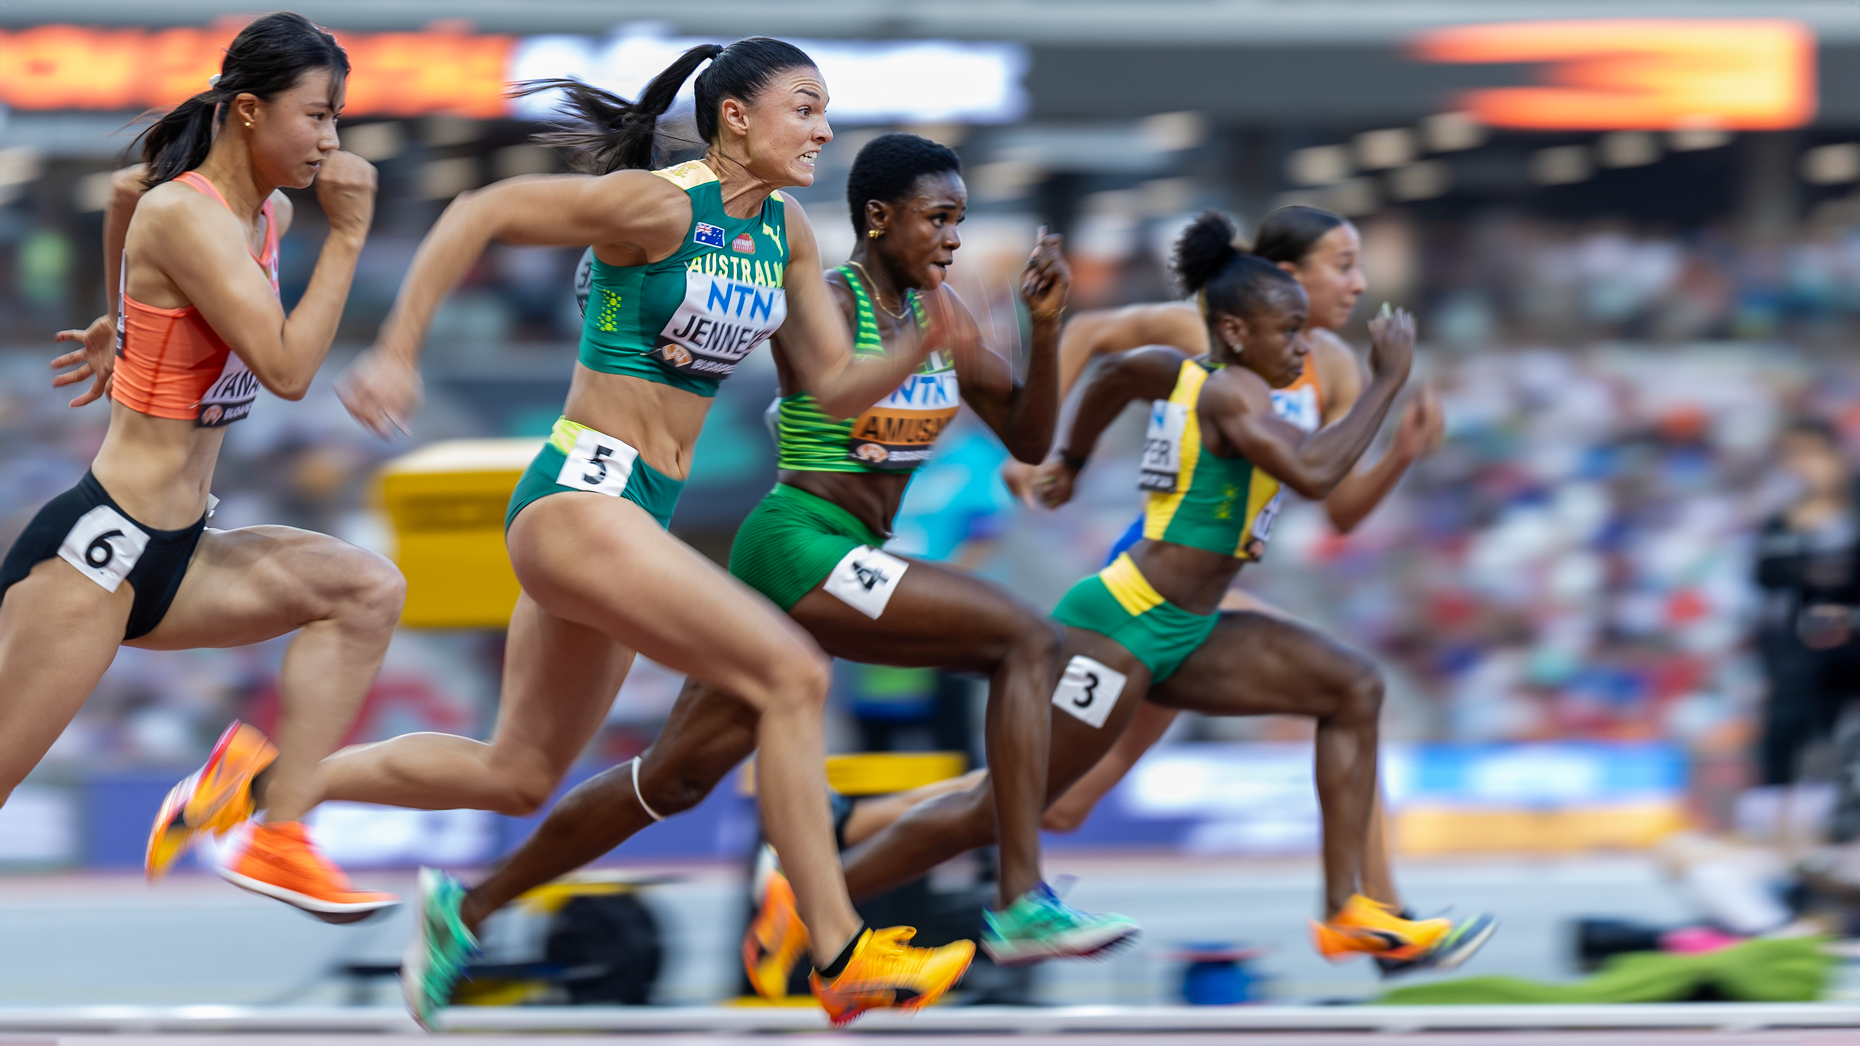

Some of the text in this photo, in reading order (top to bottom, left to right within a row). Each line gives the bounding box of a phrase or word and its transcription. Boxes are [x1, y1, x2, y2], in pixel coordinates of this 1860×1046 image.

[707, 280, 774, 324] NTN
[583, 444, 615, 486] 5
[85, 529, 126, 569] 6
[851, 560, 890, 593] 4
[1072, 671, 1100, 709] 3
